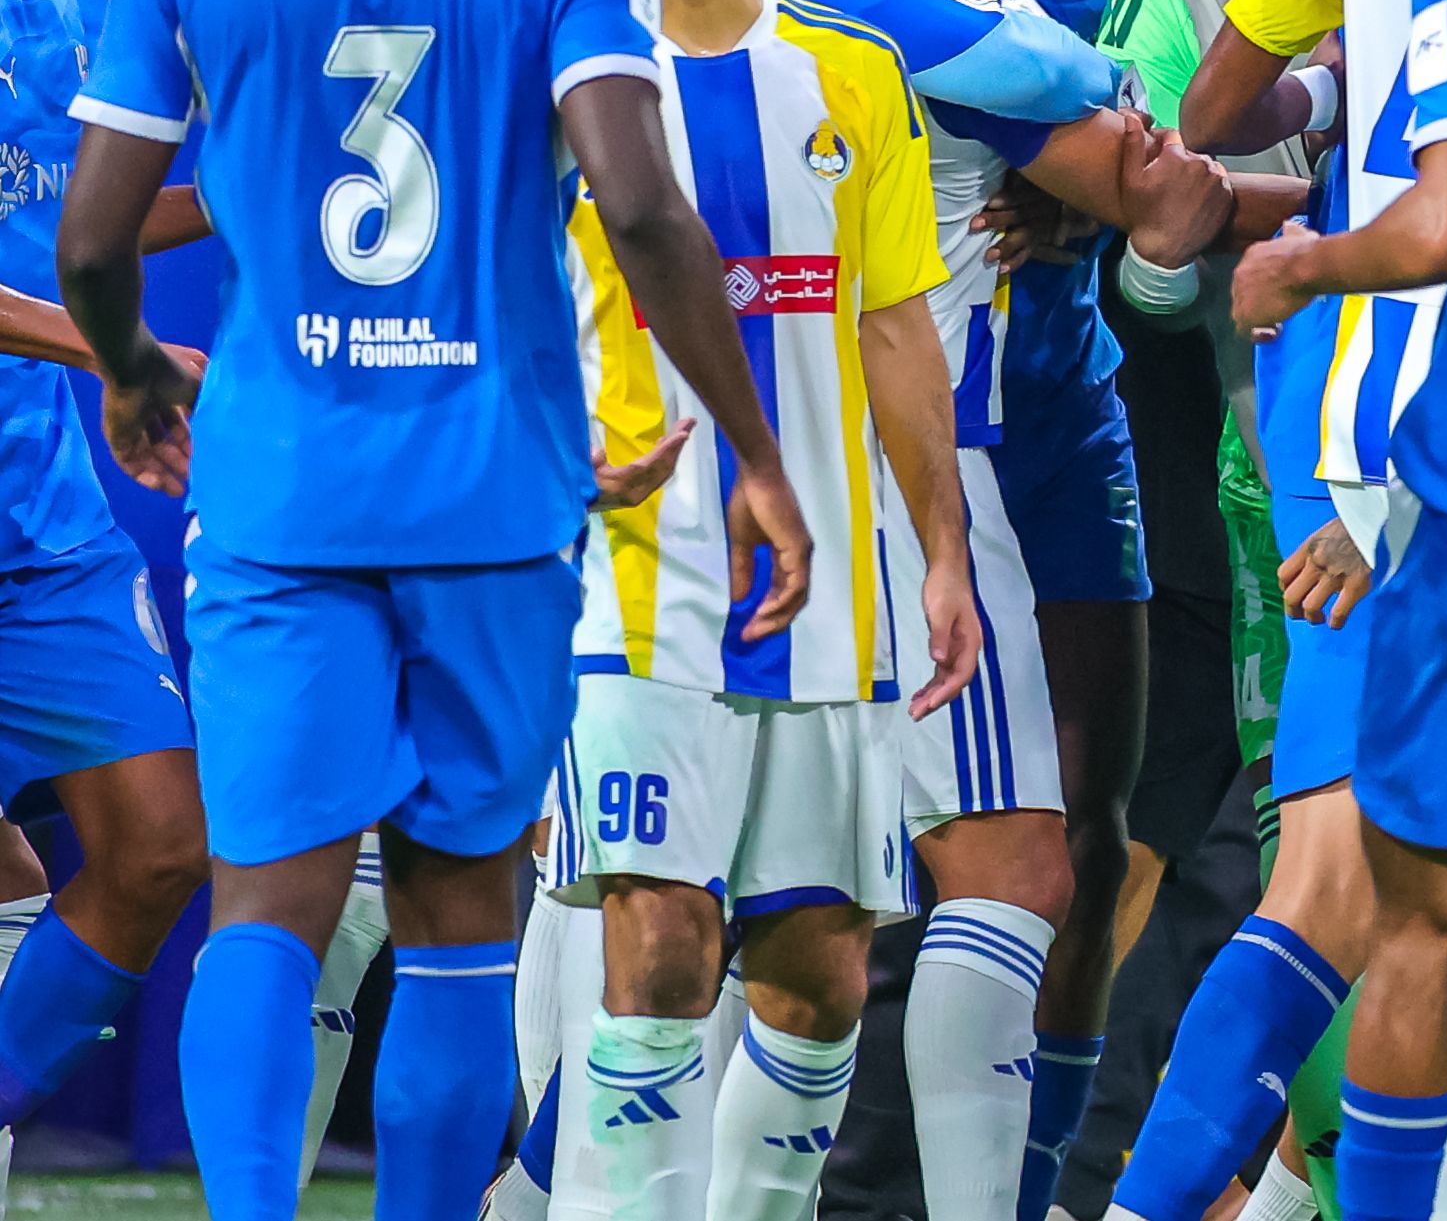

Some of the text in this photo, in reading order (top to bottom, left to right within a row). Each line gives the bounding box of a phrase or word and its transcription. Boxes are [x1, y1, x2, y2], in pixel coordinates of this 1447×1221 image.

[320, 25, 440, 287] 3
[348, 317, 435, 342] ALHILAL
[349, 341, 477, 368] FOUNDATION
[598, 770, 669, 846] 96
